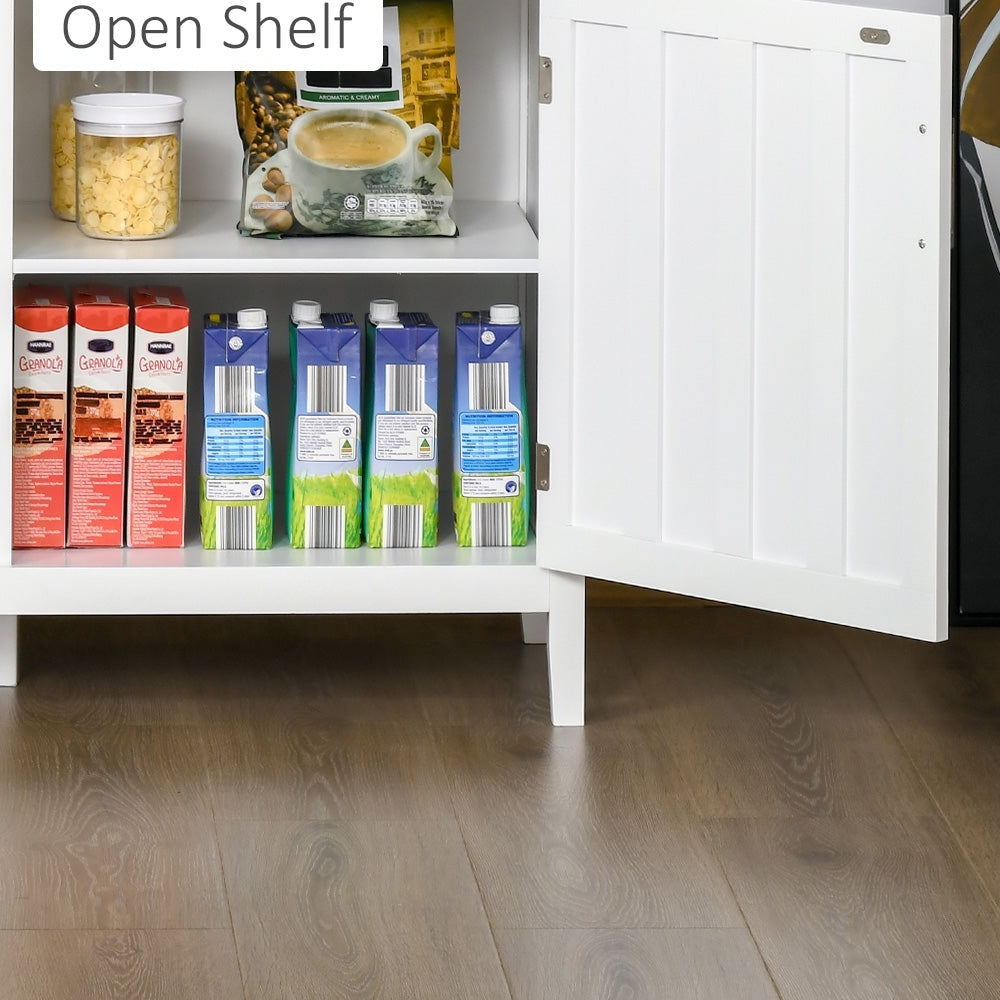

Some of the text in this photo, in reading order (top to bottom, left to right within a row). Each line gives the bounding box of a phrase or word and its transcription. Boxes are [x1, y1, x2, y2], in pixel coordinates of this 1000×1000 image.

[18, 355, 64, 372] GRANOLA
[78, 354, 123, 372] GRANOLA
[138, 356, 184, 373] GRANOLA
